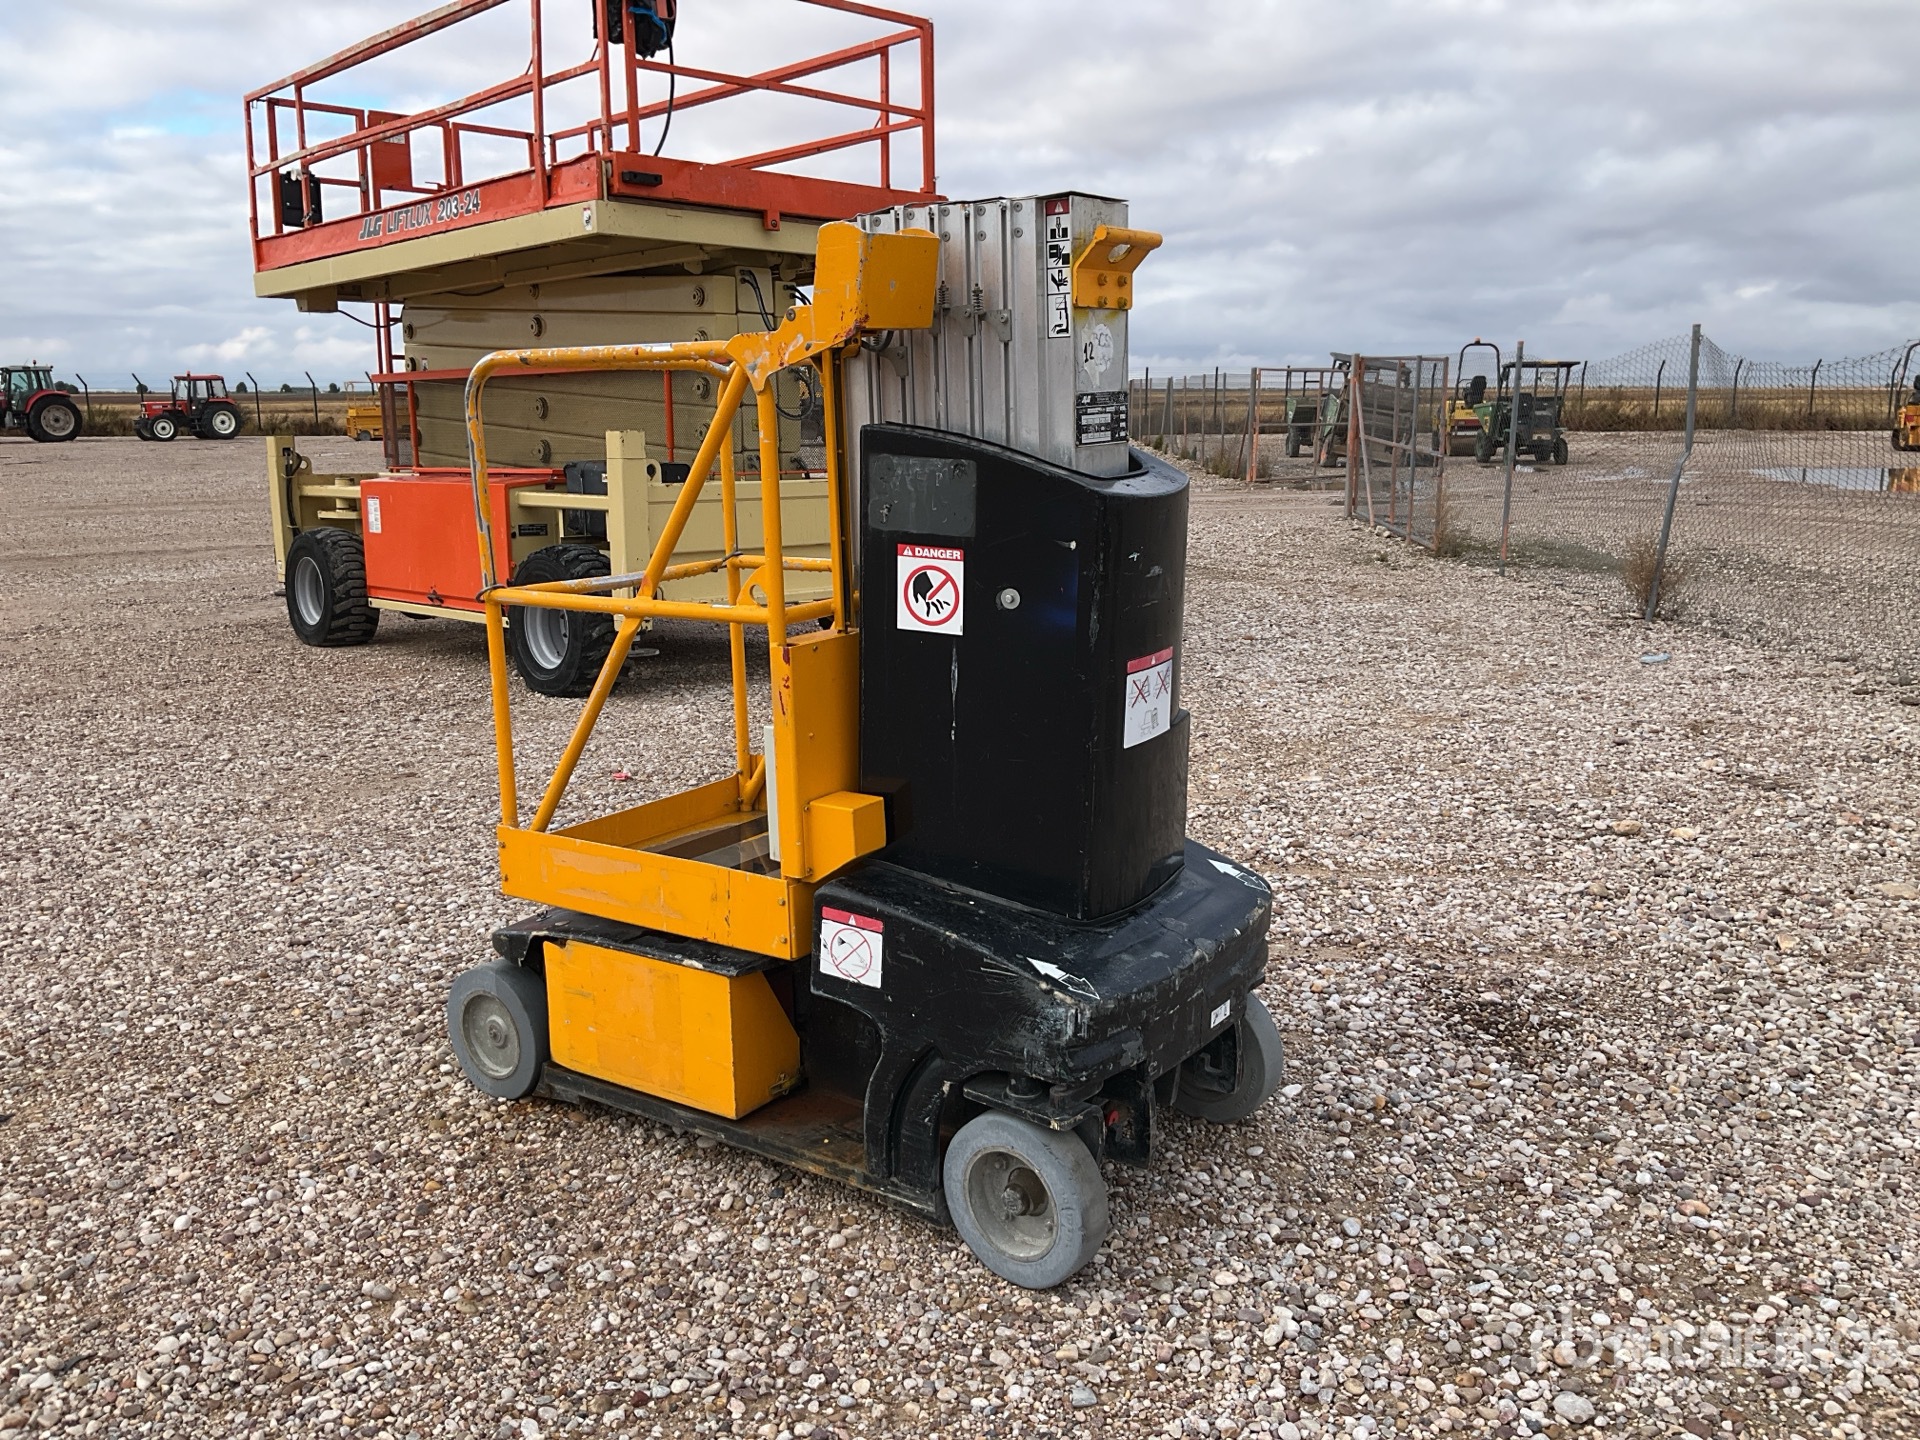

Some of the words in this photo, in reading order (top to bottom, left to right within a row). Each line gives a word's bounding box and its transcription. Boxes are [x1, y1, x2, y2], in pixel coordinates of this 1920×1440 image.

[359, 215, 383, 240] JLG
[387, 202, 433, 234] LIFTLUX
[437, 189, 481, 223] 203-24
[1083, 341, 1095, 364] 12
[914, 547, 961, 560] DANGER
